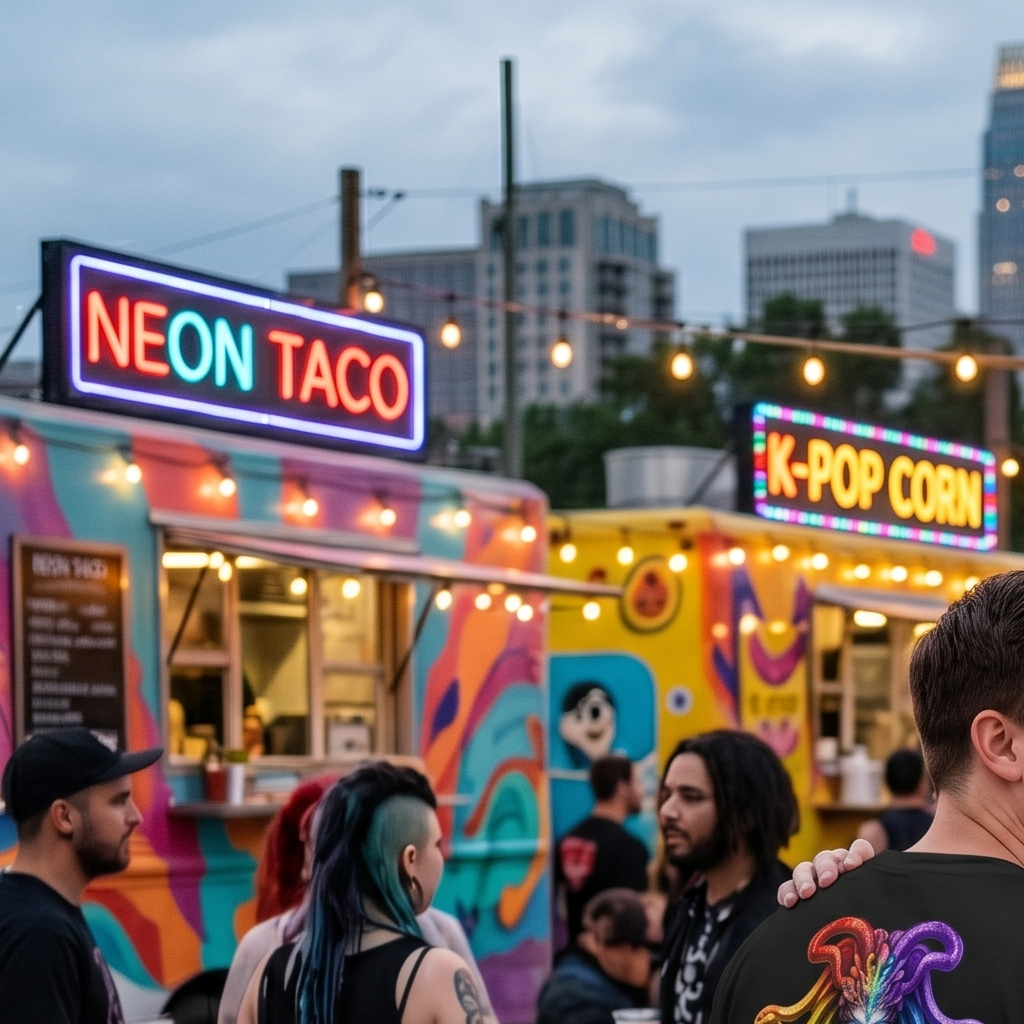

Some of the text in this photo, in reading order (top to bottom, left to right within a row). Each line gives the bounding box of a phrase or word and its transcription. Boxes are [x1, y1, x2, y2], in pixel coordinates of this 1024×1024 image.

[86, 290, 410, 421] NEON TACO
[766, 431, 983, 530] K-POP CORN
